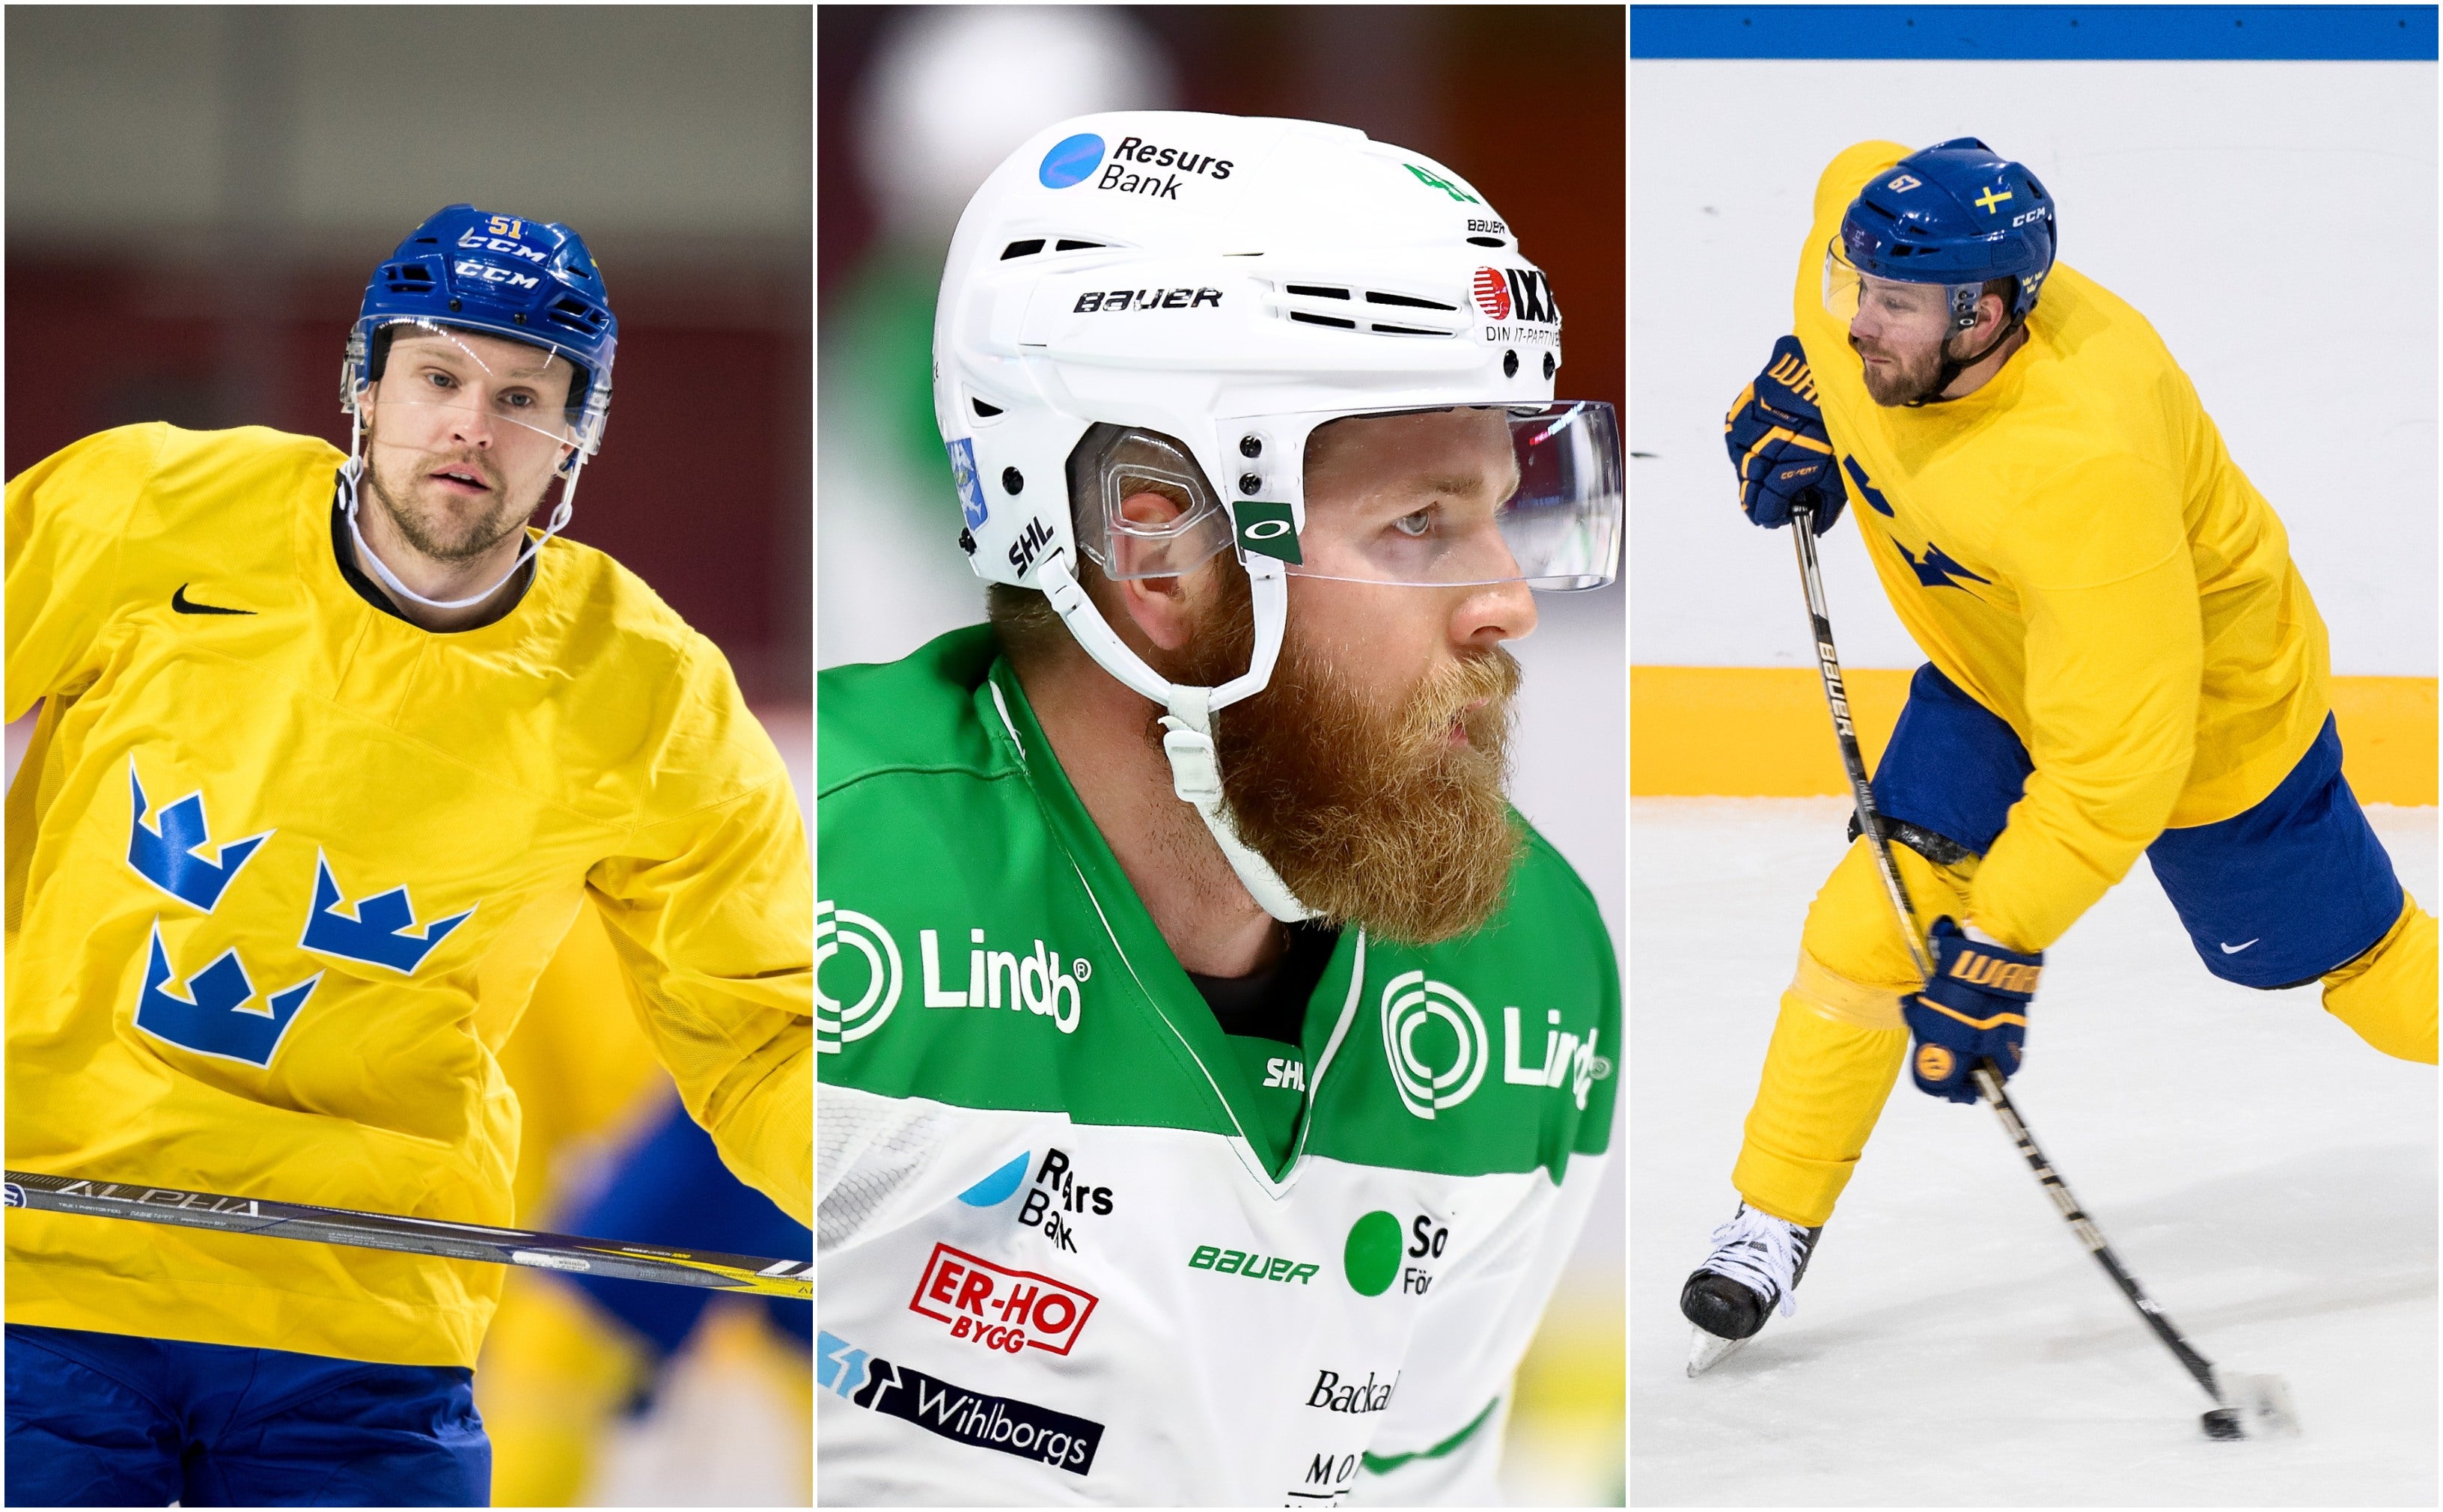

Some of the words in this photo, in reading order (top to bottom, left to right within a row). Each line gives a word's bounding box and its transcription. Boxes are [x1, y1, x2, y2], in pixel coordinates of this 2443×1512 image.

[1113, 136, 1234, 180] Resurs
[1098, 164, 1183, 201] Bank
[1888, 174, 1922, 194] 67
[488, 216, 522, 240] 51
[1467, 219, 1506, 234] BAUER
[2012, 207, 2046, 228] CCM
[458, 236, 547, 261] CCM
[455, 263, 540, 289] CCM
[1073, 287, 1223, 313] BAUER
[1486, 326, 1510, 341] DIN
[1008, 516, 1055, 580] SHL
[1817, 641, 1856, 737] BAUER
[1263, 1058, 1305, 1092] SHL
[1187, 1245, 1320, 1285] BAUER
[928, 1260, 1077, 1334] ER-HO
[950, 1315, 1025, 1353] BYGG
[918, 1379, 1088, 1469] Wihlborgs
